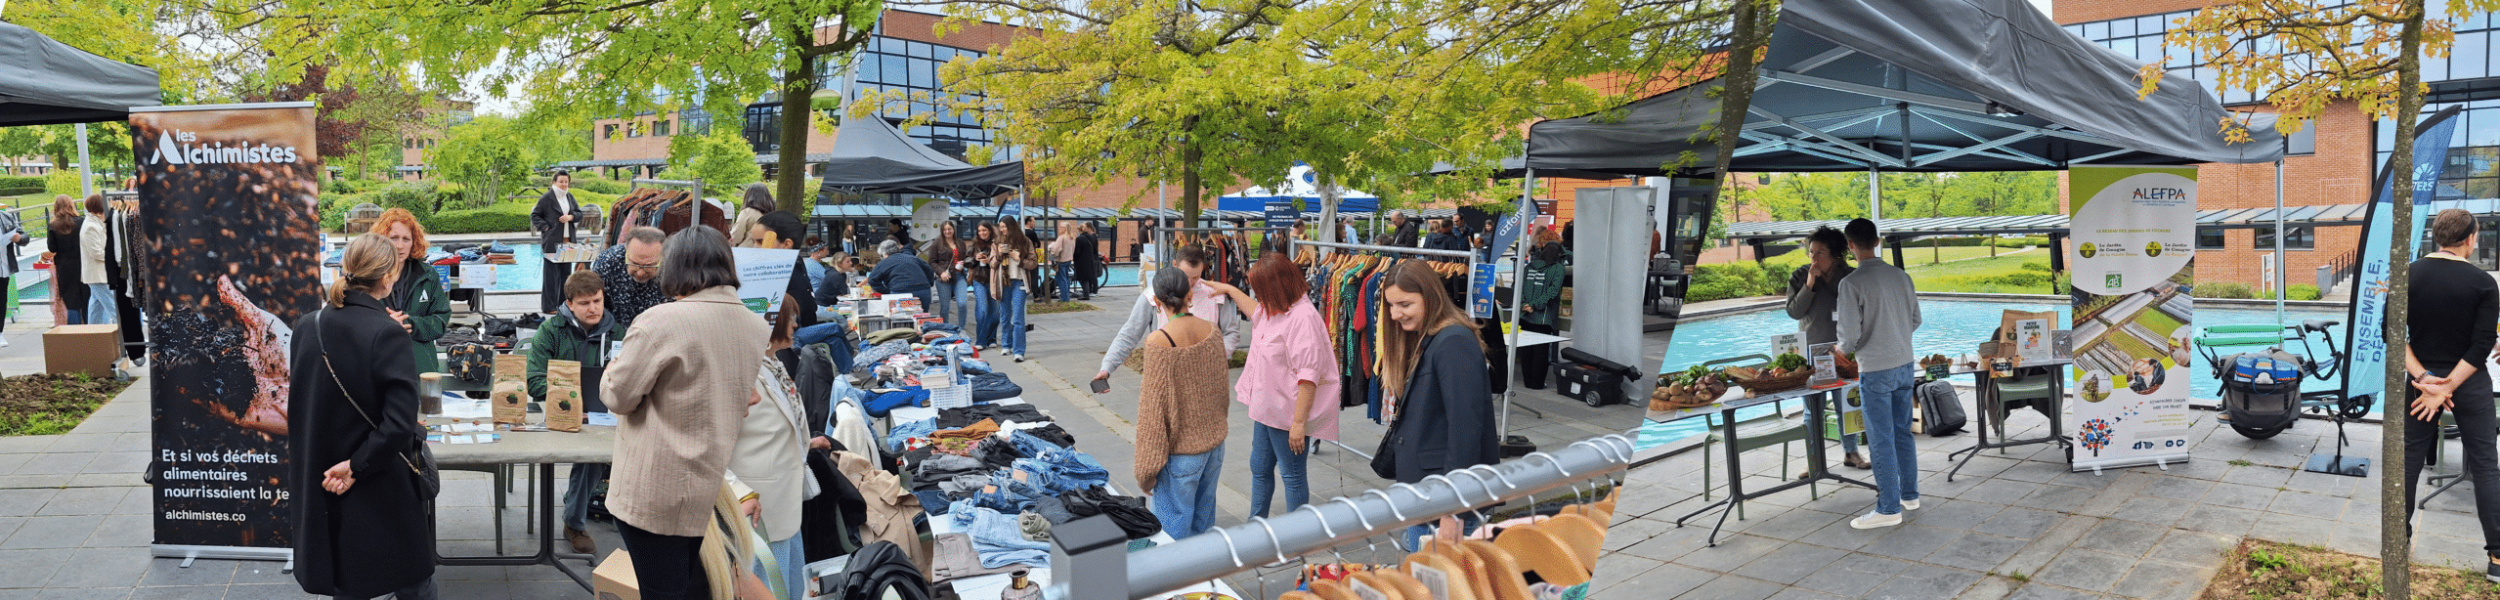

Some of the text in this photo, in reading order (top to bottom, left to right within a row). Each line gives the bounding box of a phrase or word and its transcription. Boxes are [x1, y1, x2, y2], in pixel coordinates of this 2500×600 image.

[176, 129, 196, 142] les
[2132, 188, 2186, 200] ALEFPA
[162, 449, 278, 464] Et si vos déchets
[163, 467, 248, 481] alimentaires
[164, 485, 256, 499] nourrissaient
[260, 486, 272, 500] la
[166, 510, 246, 522] alchimistes.co
